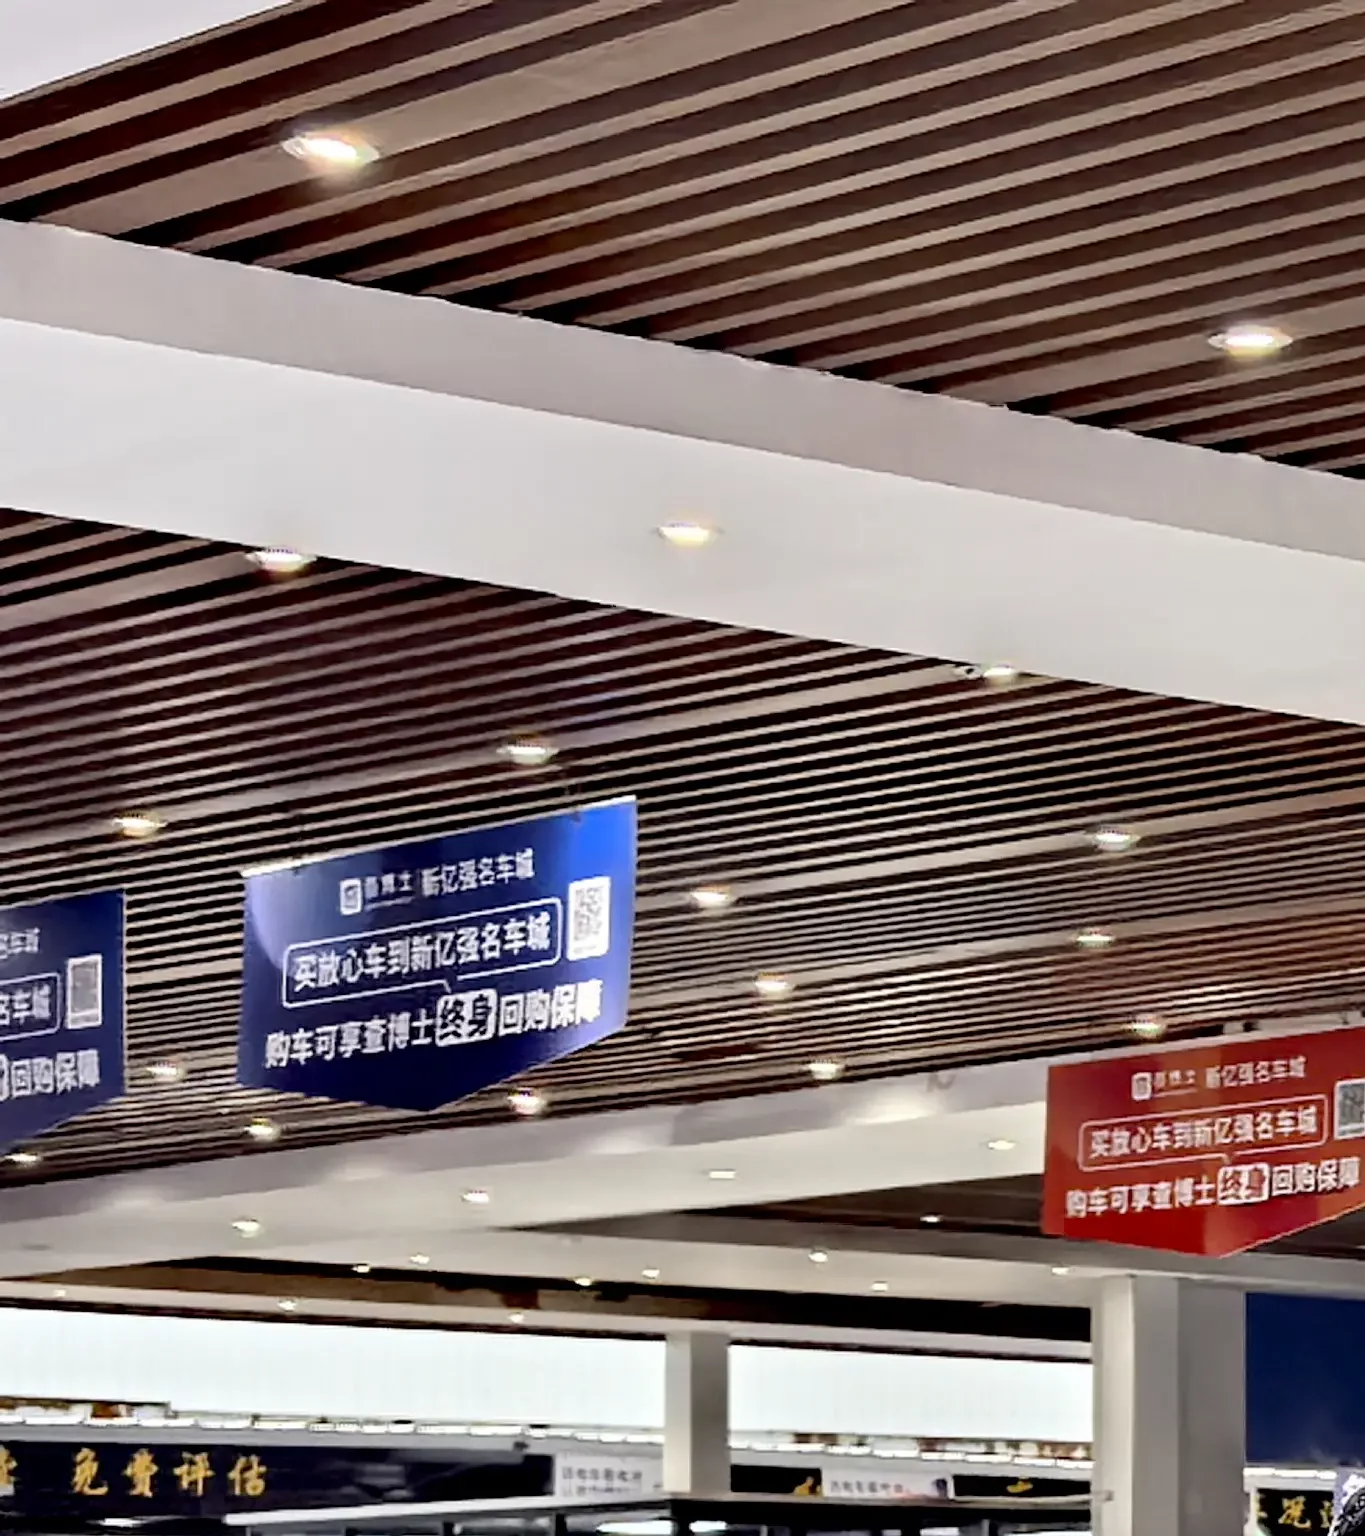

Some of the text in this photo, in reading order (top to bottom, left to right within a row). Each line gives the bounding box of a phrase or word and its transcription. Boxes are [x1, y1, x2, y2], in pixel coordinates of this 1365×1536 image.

[293, 911, 551, 993] 买放心车到新亿强名车城
[264, 979, 603, 1070] 购车可享查博士终身回购保障
[1089, 1105, 1318, 1160] 买放心车到新亿强名车城
[1065, 1156, 1361, 1218] 购车可享查博士终身回购保障
